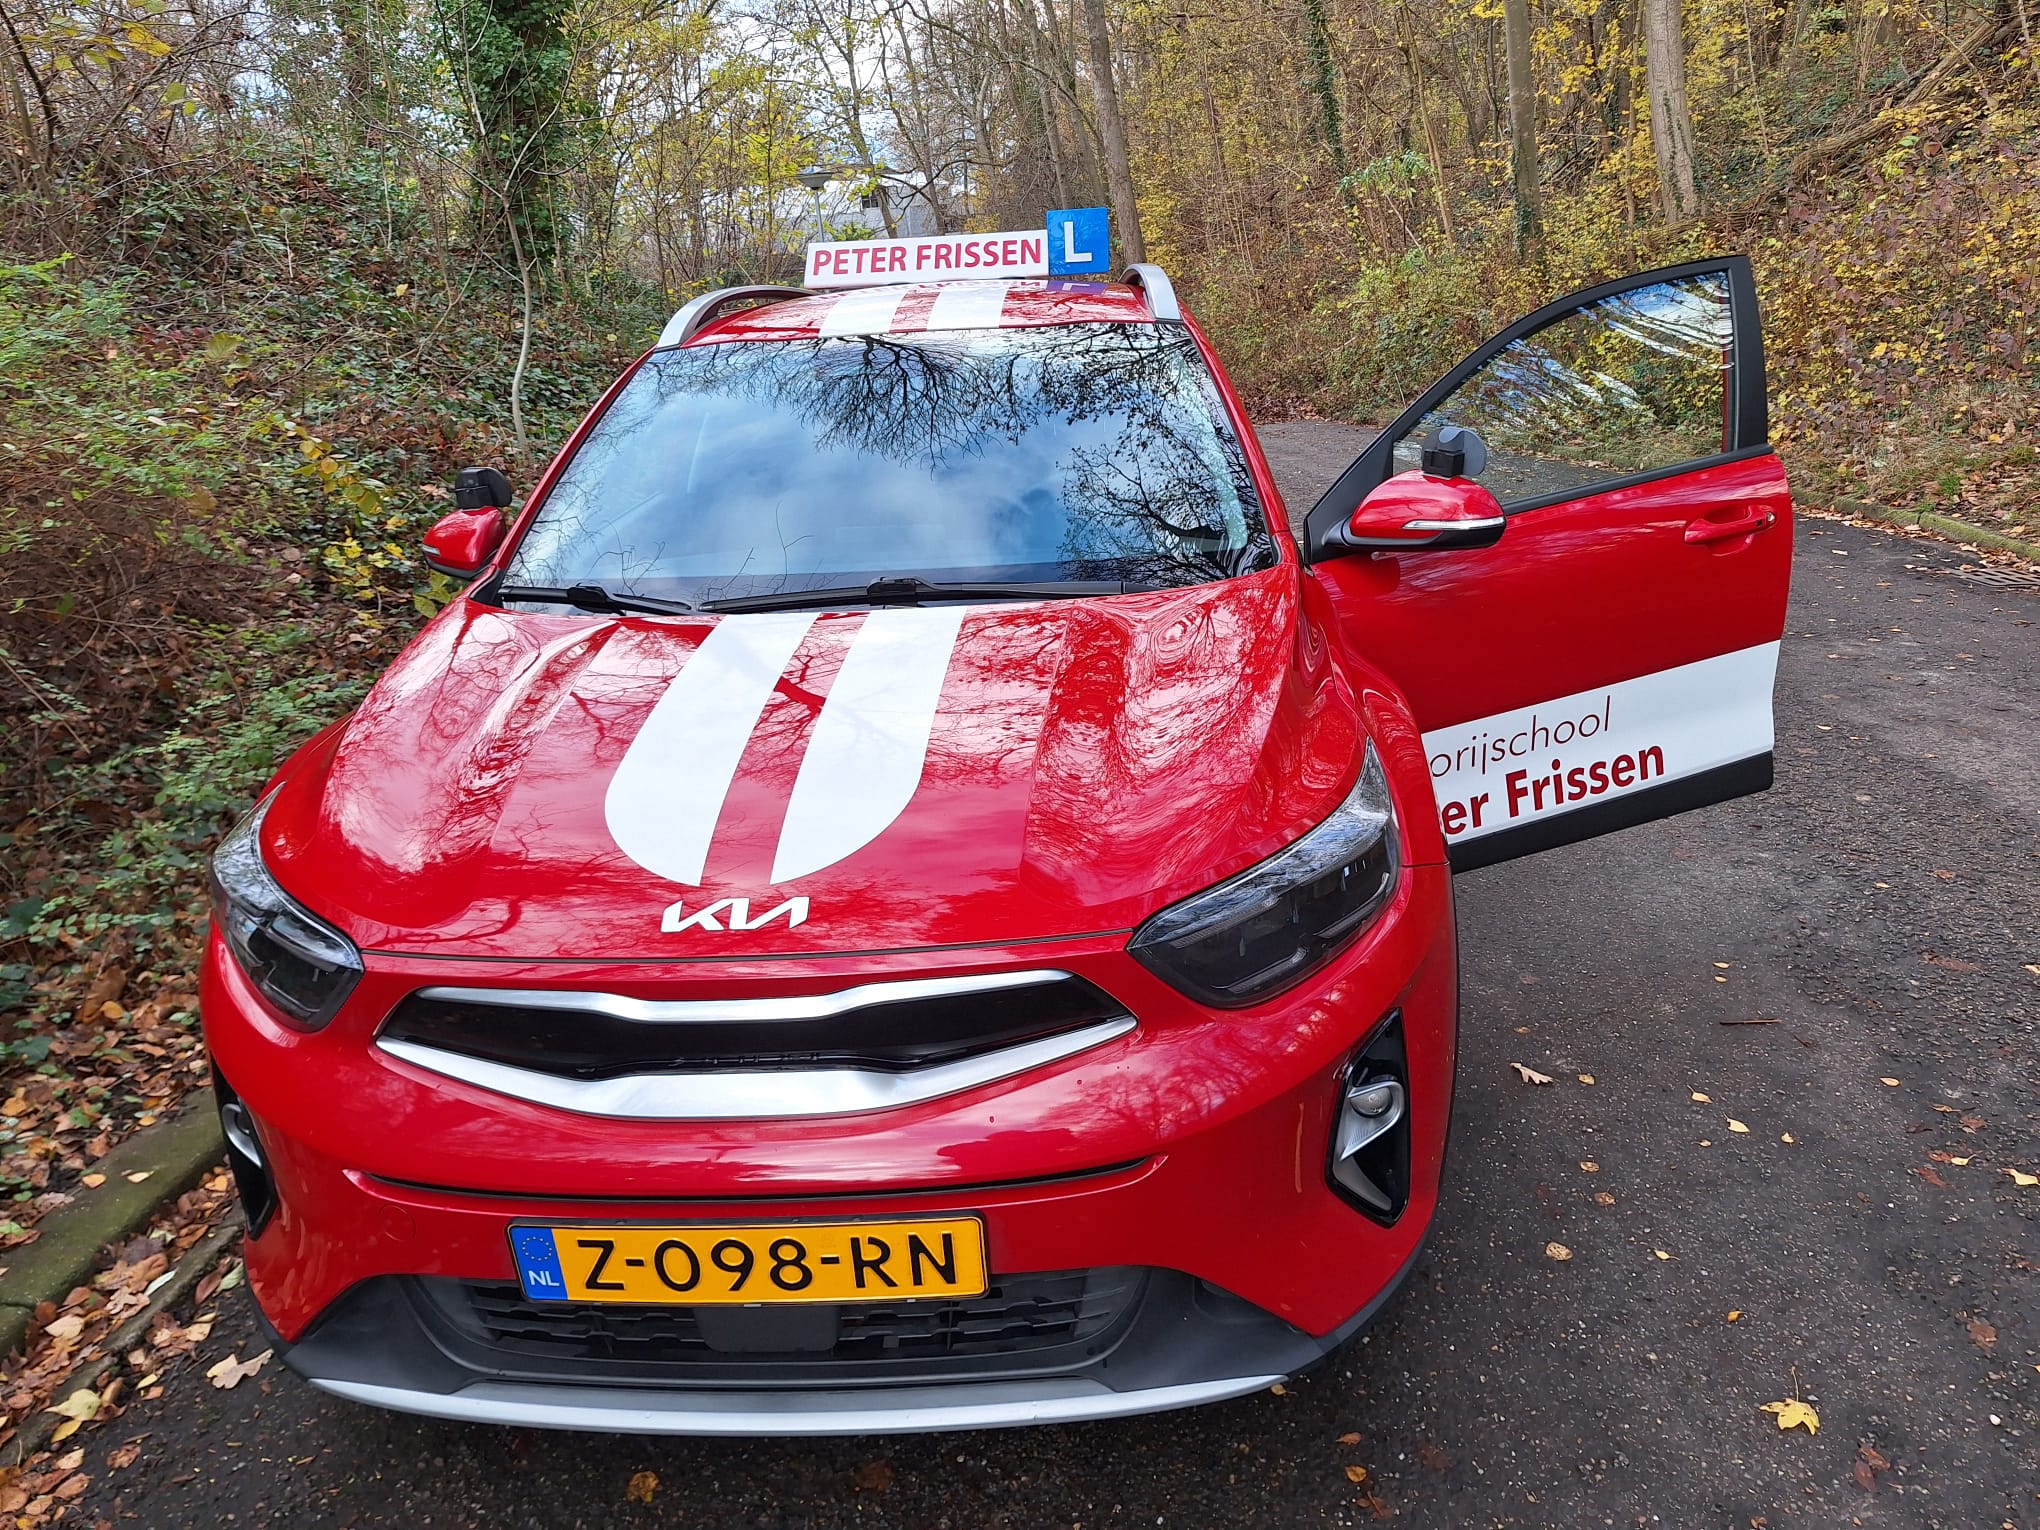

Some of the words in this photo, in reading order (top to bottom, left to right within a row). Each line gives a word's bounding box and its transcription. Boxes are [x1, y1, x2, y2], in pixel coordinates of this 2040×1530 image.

[812, 245, 906, 276] PETER
[915, 238, 1042, 271] FRISSEN
[1063, 221, 1092, 263] L
[1505, 745, 1665, 818] Frissen
[660, 896, 810, 933] KIA
[528, 1269, 560, 1288] NL
[576, 1232, 957, 1292] Z-098-RN
